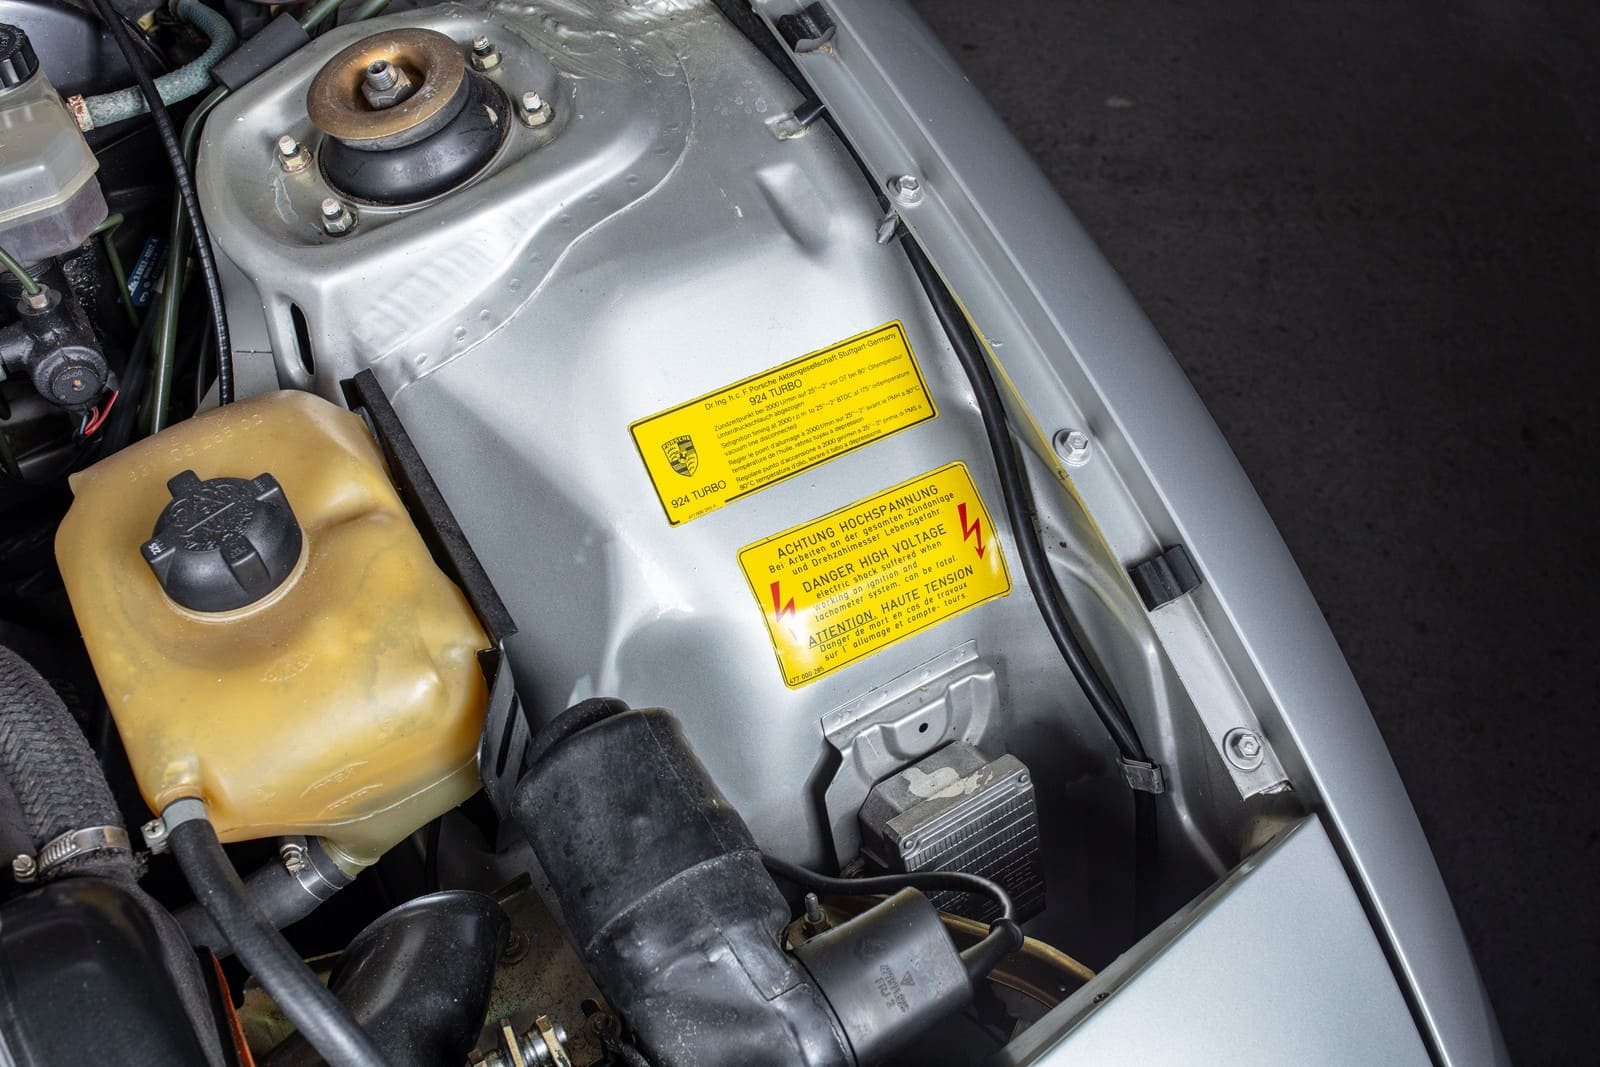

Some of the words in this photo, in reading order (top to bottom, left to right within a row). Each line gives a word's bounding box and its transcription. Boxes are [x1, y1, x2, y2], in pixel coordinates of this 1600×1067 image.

[747, 378, 778, 394] Porsche
[778, 352, 838, 383] Aktiengesellschaft
[748, 391, 768, 406] 924
[767, 376, 803, 399] TURBO
[764, 400, 780, 412] 2000
[776, 415, 792, 427] 2000
[805, 424, 821, 435] 2000
[820, 437, 837, 448] 2000
[670, 494, 690, 509] 924
[690, 479, 727, 500] TURBO
[768, 561, 785, 574] Bei
[788, 545, 827, 566] Arbeiten
[829, 537, 841, 548] an
[844, 531, 858, 543] der
[862, 513, 904, 536] gesamten
[905, 492, 955, 517] Zündanlage
[777, 527, 835, 559] ACHTUNG
[838, 484, 938, 533] HOCHSPANNUNG
[791, 562, 809, 575] und
[811, 533, 880, 567] Drehzahlmesser
[801, 562, 855, 593] DANGER
[858, 547, 890, 569] HIGH
[891, 523, 947, 554] VOLTAGE
[815, 578, 850, 599] electric
[852, 567, 878, 583] shock
[880, 549, 917, 572] suffered
[919, 540, 942, 554] when
[815, 591, 849, 611] working
[852, 585, 863, 595] on
[866, 570, 899, 589] ignition
[902, 560, 918, 573] and
[815, 595, 863, 622] tachometer
[904, 572, 919, 583] can
[921, 566, 933, 575] be
[880, 587, 921, 614] HAUTE
[923, 564, 974, 594] TENSION
[817, 634, 850, 653] Danger
[854, 628, 865, 637] de
[868, 616, 889, 631] mort
[892, 611, 903, 620] en
[906, 602, 921, 614] cas
[923, 597, 934, 606] de
[936, 581, 967, 599] travaux
[824, 650, 838, 661] sur
[852, 626, 891, 648] allumage
[894, 620, 903, 629] et
